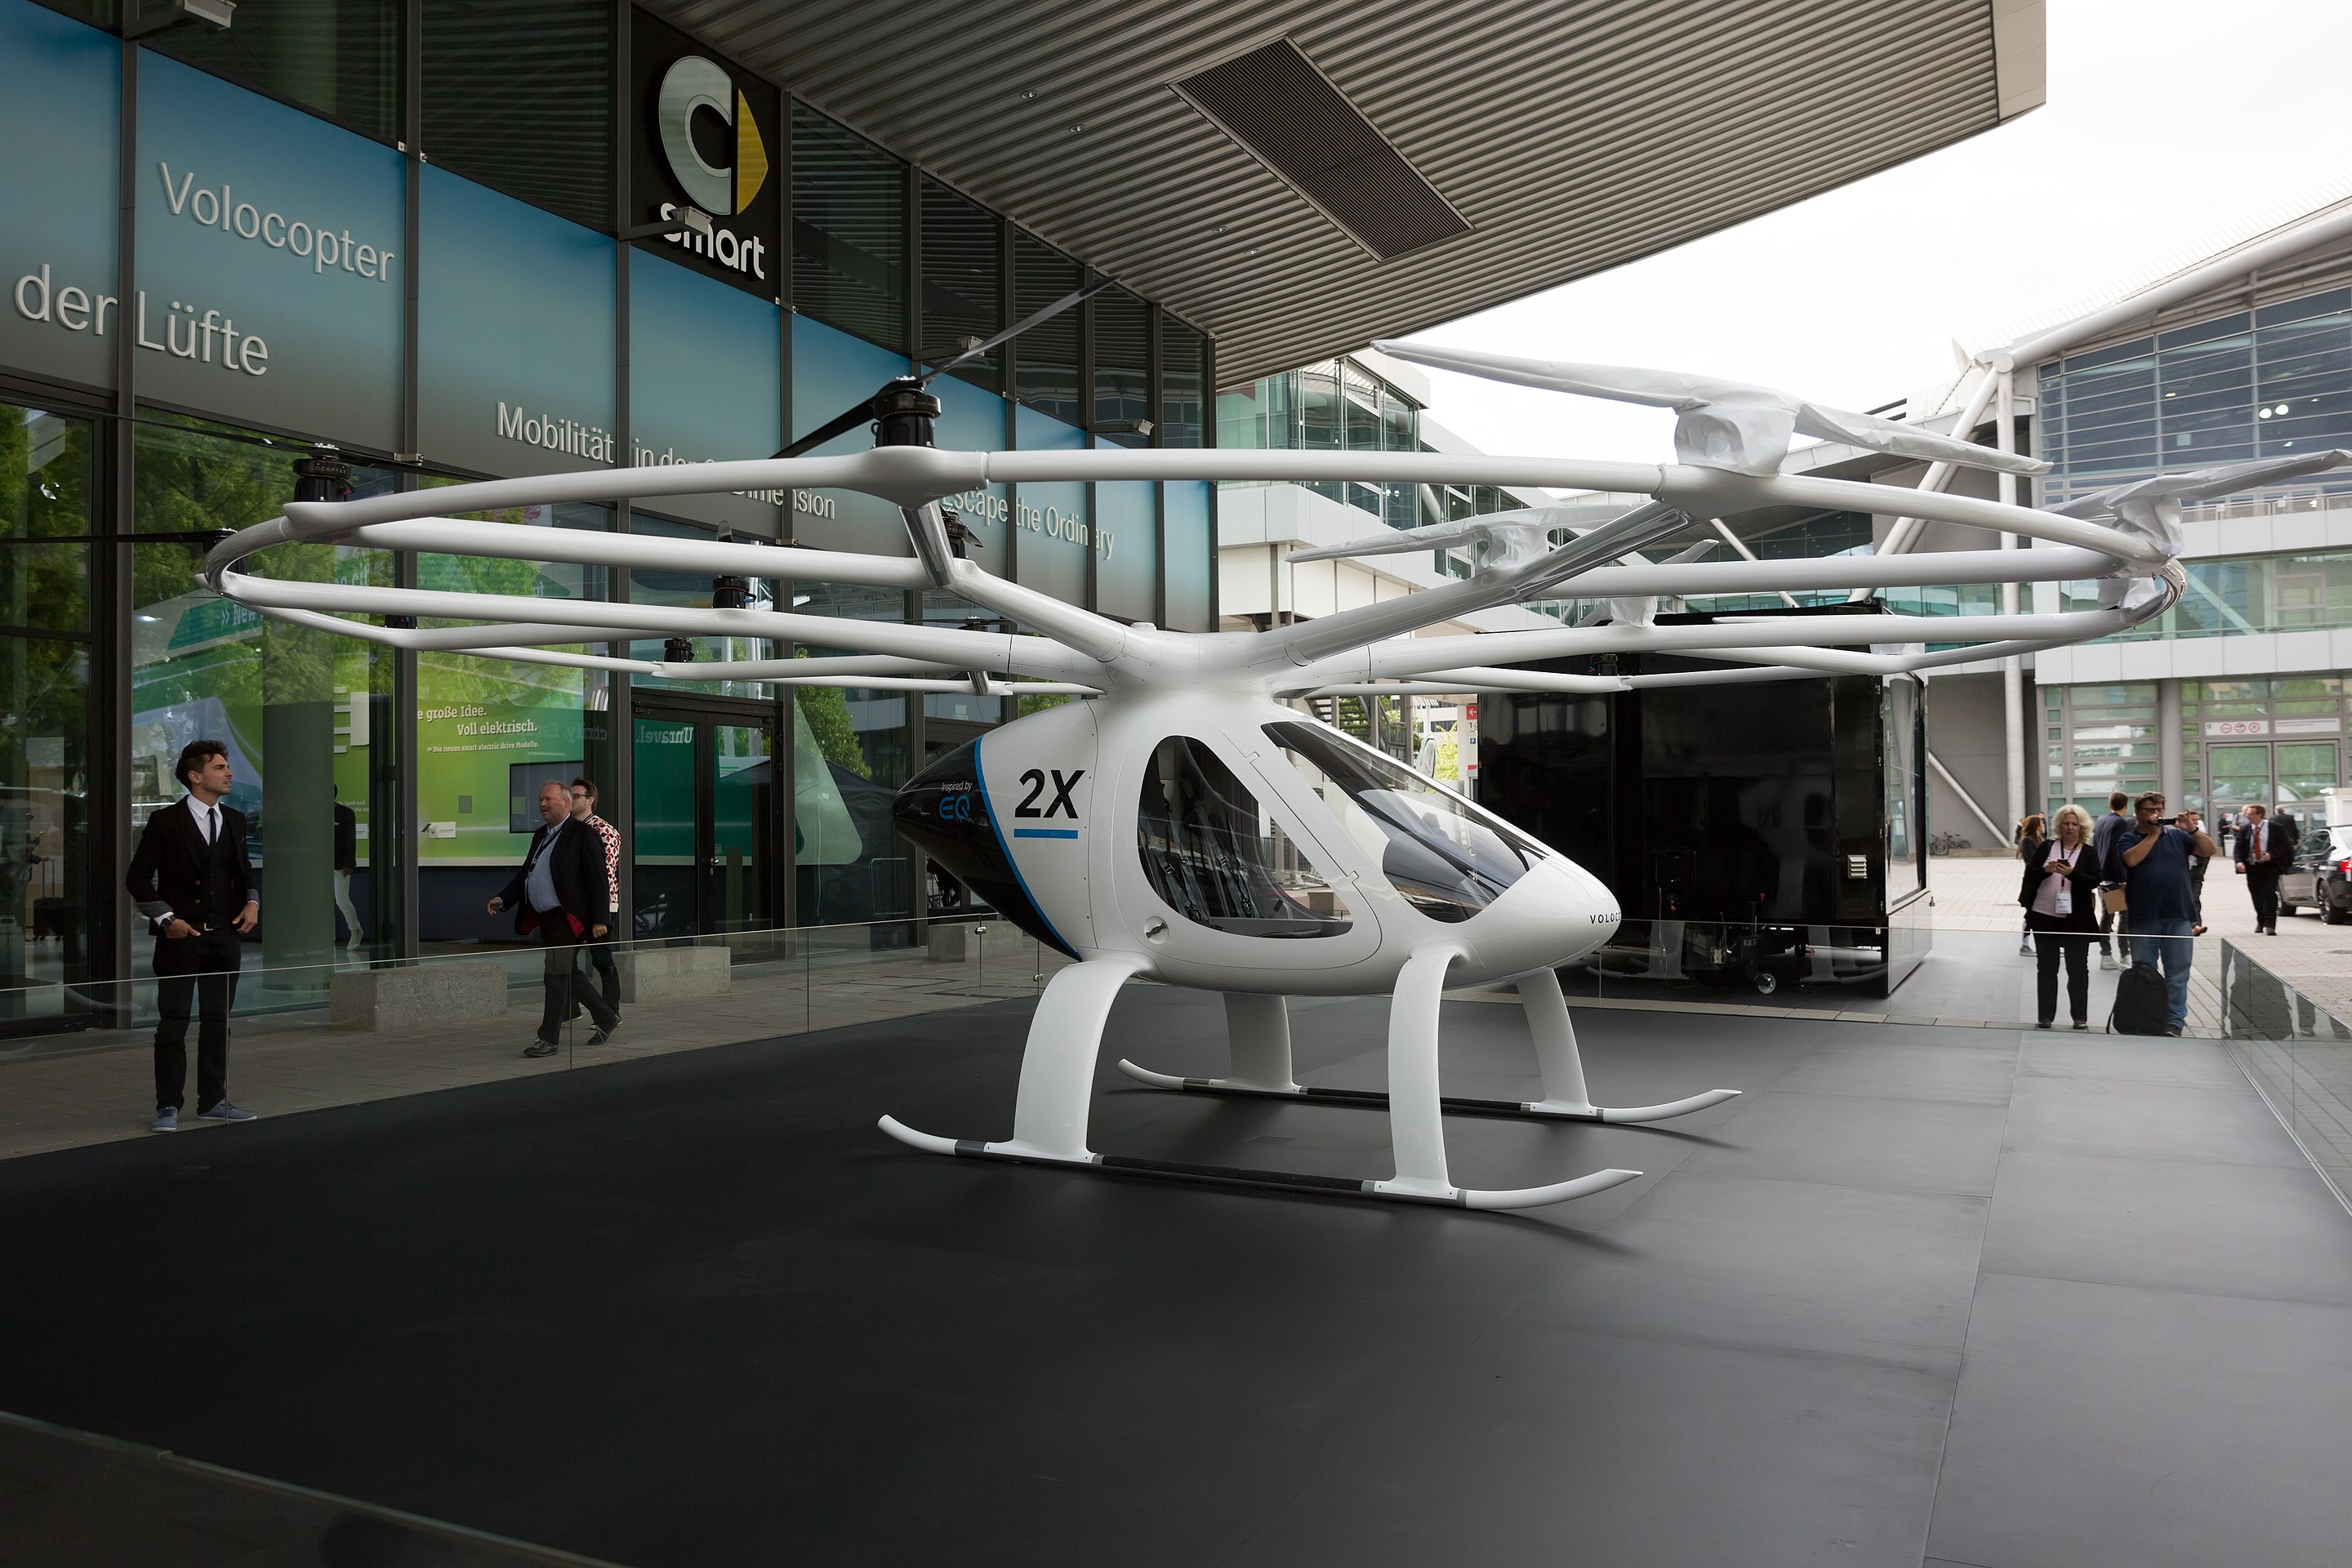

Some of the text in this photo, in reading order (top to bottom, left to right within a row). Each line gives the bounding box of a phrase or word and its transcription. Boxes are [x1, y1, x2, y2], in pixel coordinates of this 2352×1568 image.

[159, 162, 395, 282] Volocopter
[15, 263, 269, 376] der Lüfte
[497, 401, 615, 464] Mobilität
[1016, 497, 1041, 532] the
[426, 706, 458, 723] große
[461, 704, 487, 718] Idee.
[457, 719, 538, 736] Voll elektrisch.
[479, 742, 499, 751] electric
[516, 740, 539, 749] Modelle.
[941, 780, 973, 793] Inspired by
[1014, 768, 1086, 819] 2X
[939, 795, 970, 820] EQ
